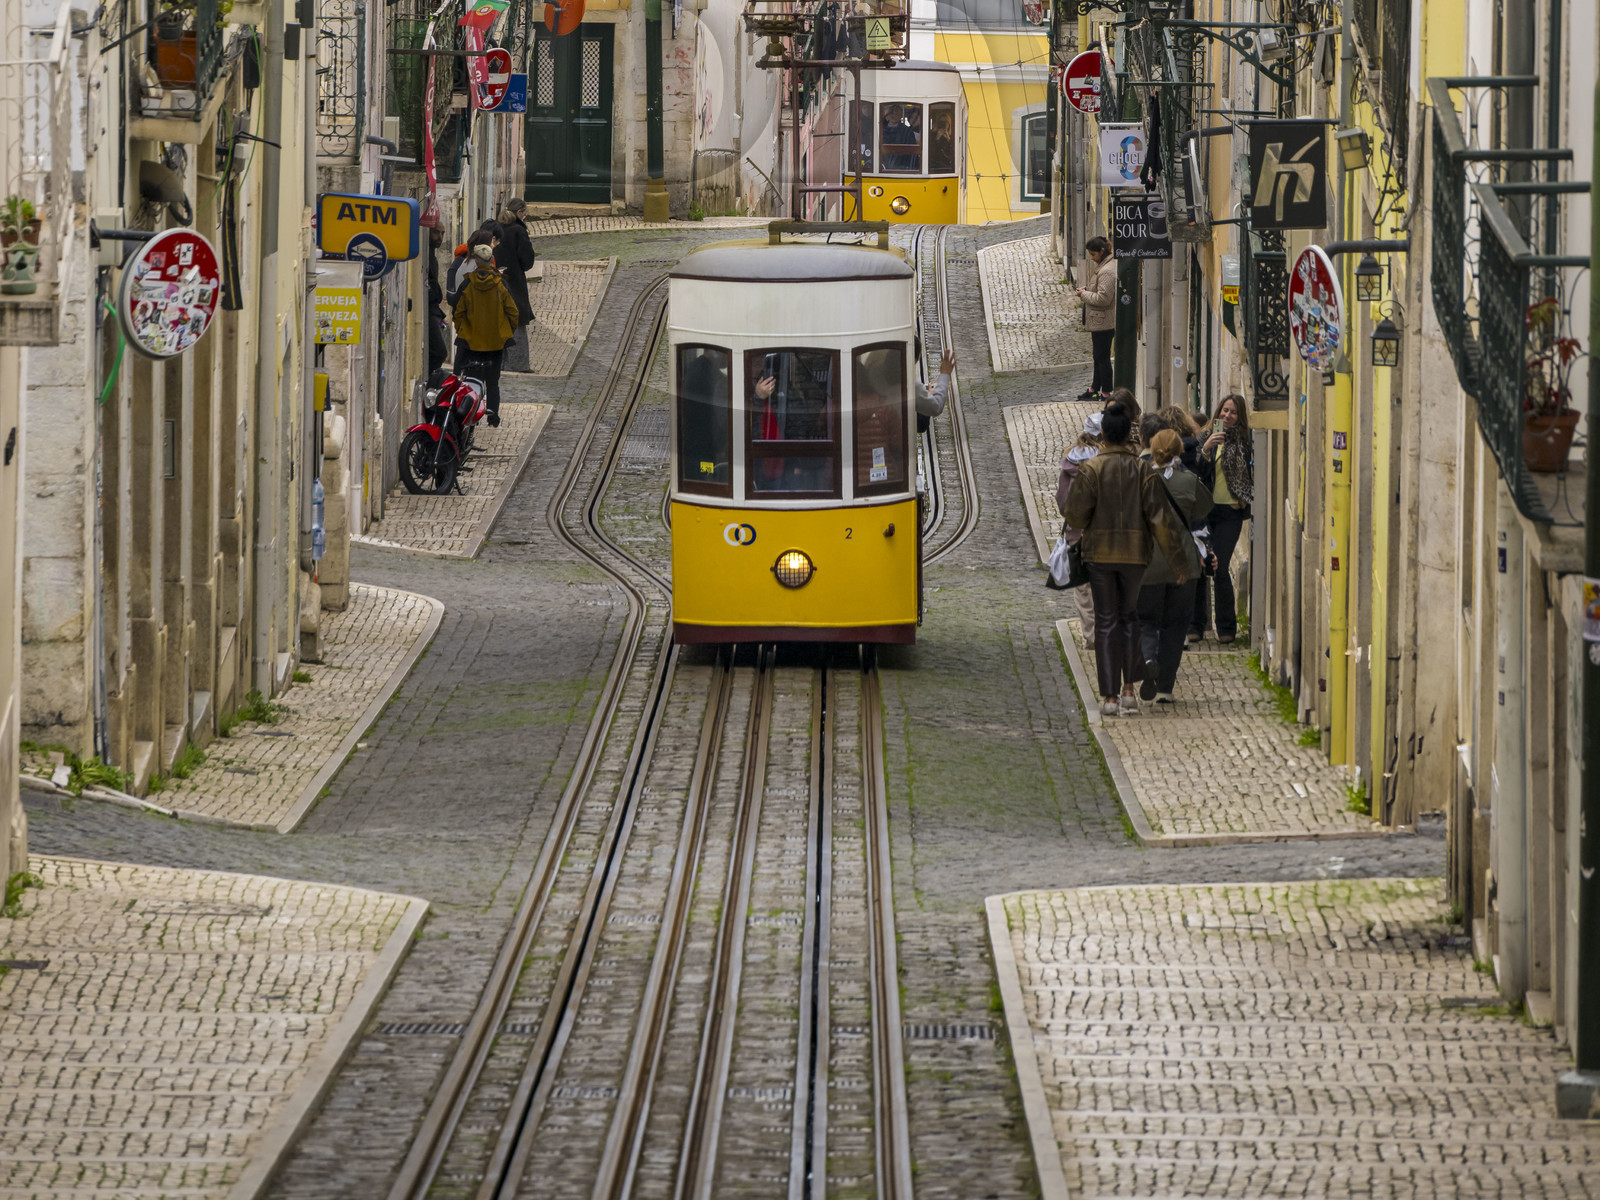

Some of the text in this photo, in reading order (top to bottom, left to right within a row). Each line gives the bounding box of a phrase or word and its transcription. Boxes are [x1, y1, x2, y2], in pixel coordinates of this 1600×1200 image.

[1109, 151, 1145, 166] CHOCL
[337, 202, 398, 226] ATM
[1115, 205, 1143, 220] BICA
[1115, 223, 1147, 238] SOUR
[314, 295, 358, 307] ERVEJA
[314, 311, 358, 321] ERVEZA
[845, 527, 853, 540] 2
